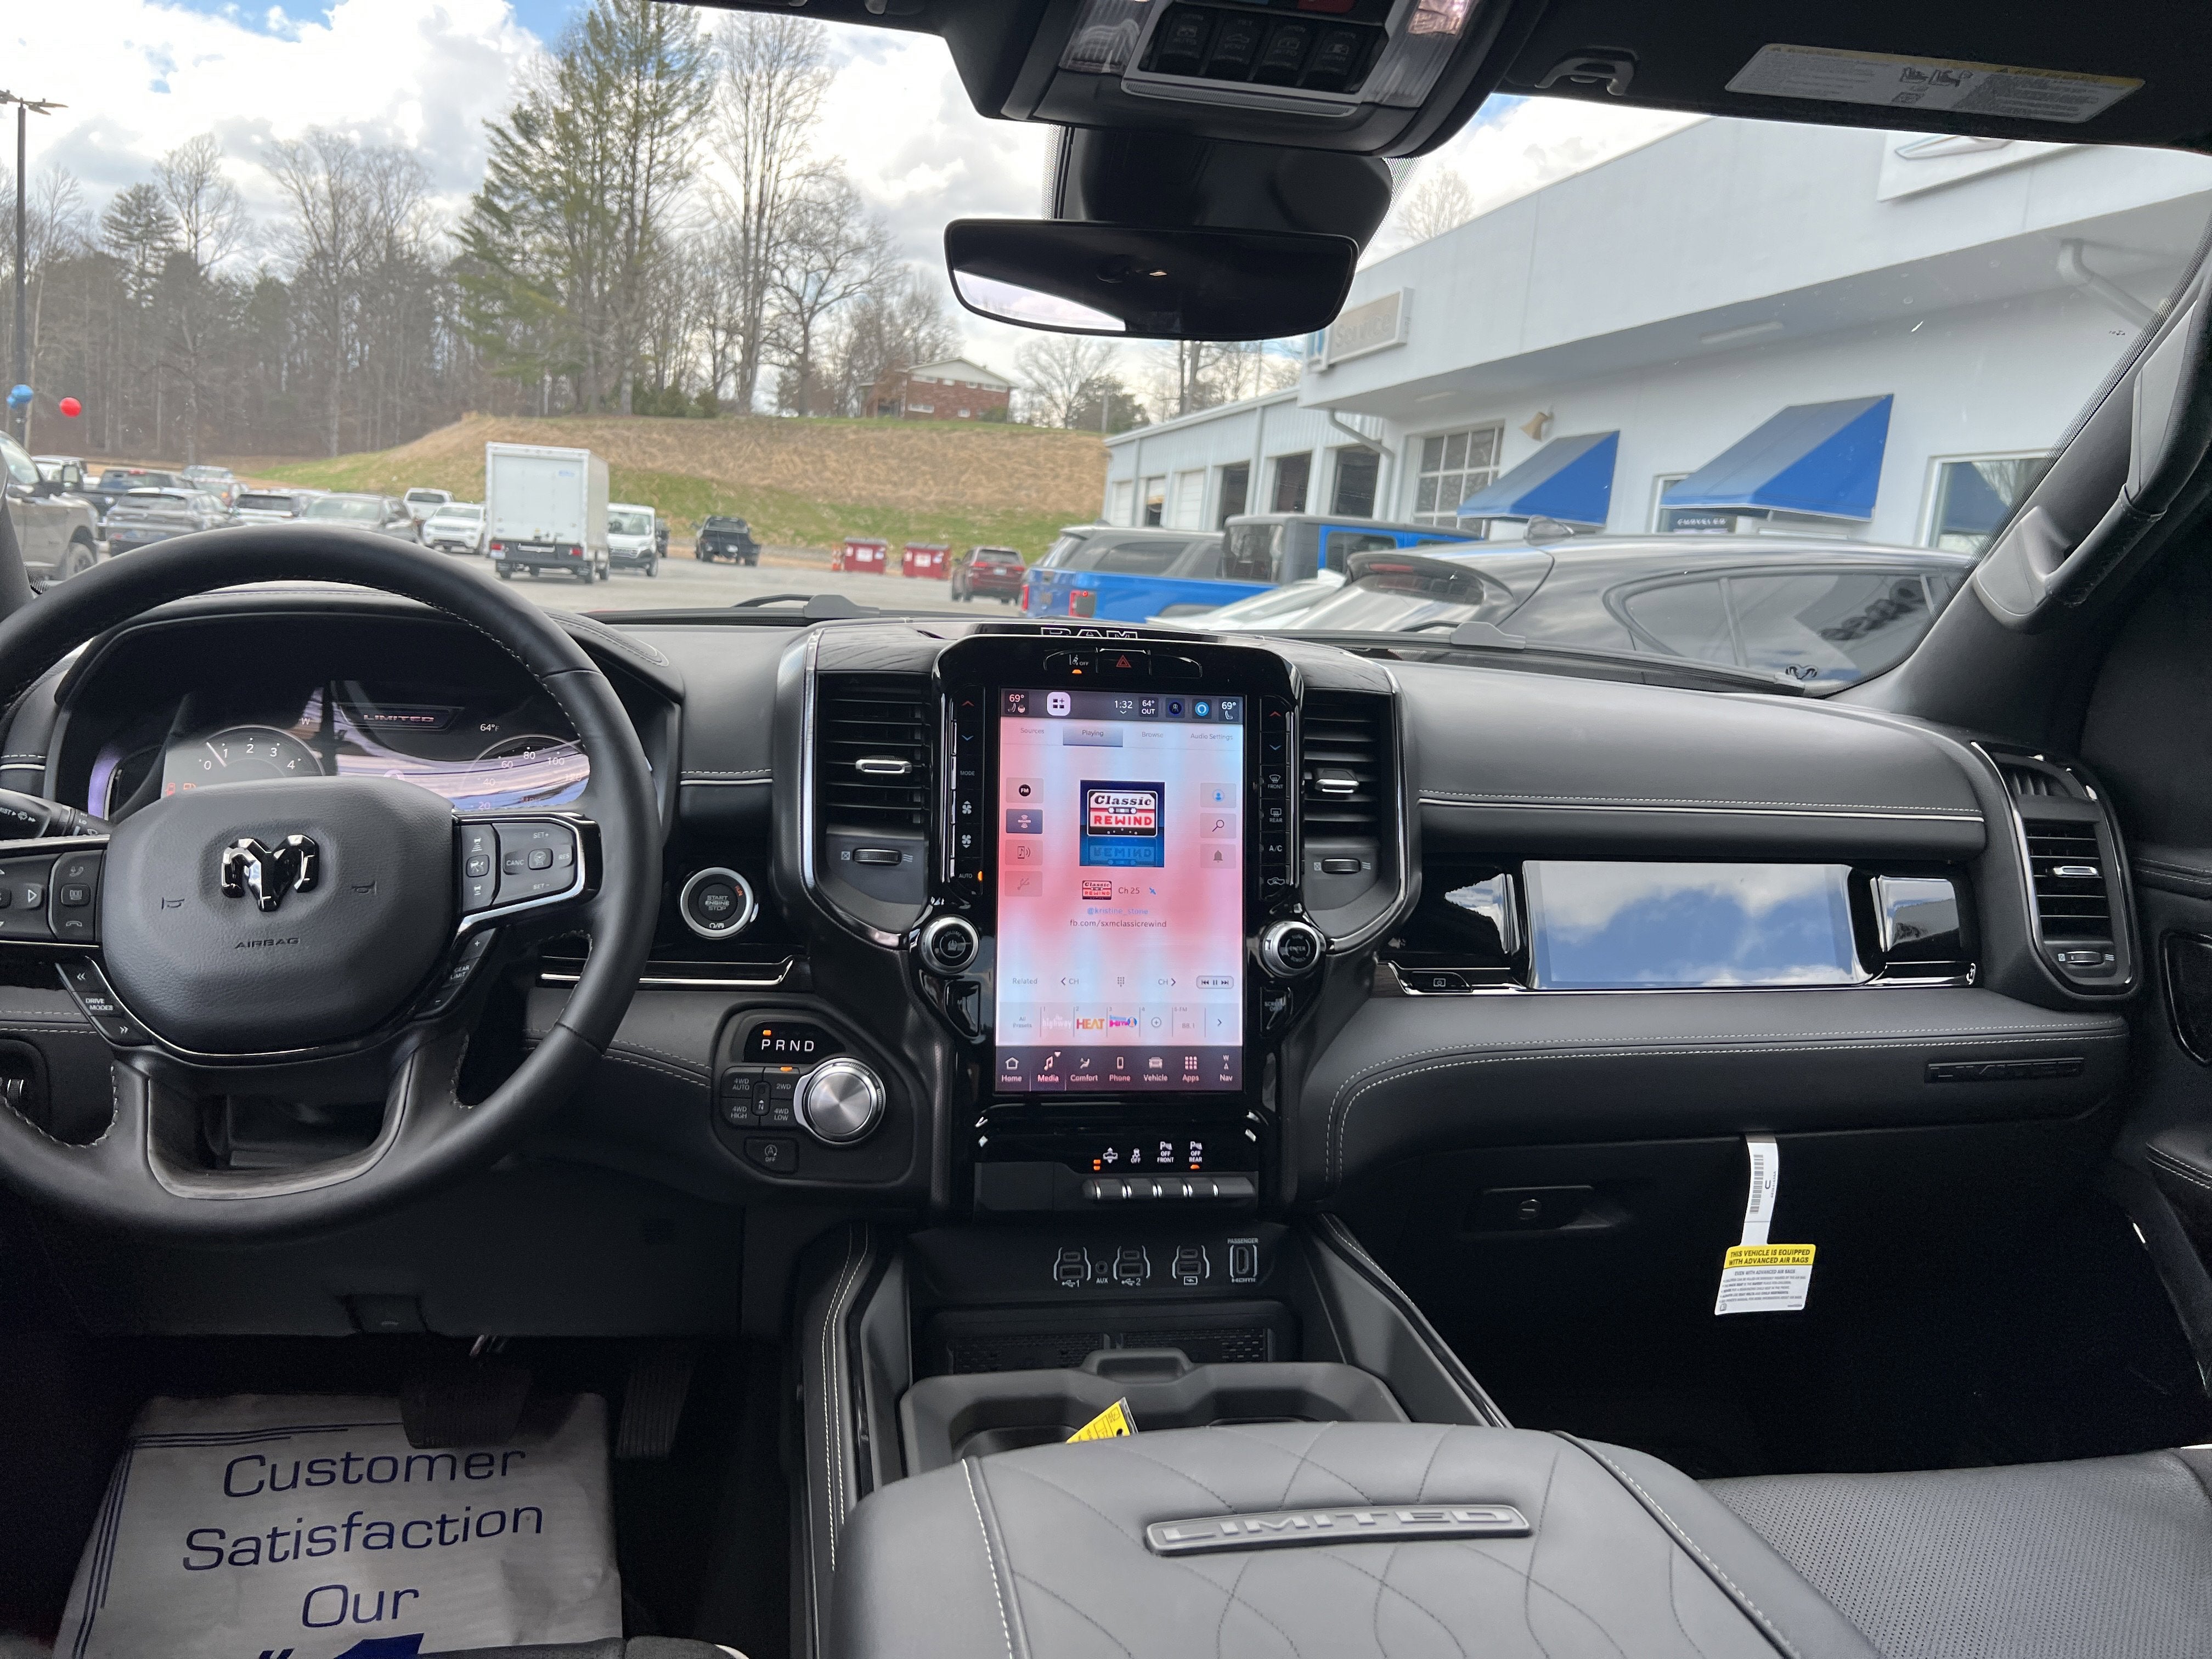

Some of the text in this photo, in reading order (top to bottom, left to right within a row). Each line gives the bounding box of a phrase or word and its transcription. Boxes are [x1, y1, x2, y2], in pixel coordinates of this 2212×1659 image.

[1335, 314, 1392, 348] Service
[1040, 627, 1138, 639] RAM
[1009, 694, 1025, 703] 69°
[1114, 700, 1133, 709] 1:32
[1221, 701, 1237, 710] 69°
[301, 717, 311, 725] W
[223, 748, 229, 758] 1
[246, 743, 254, 754] 2
[269, 747, 278, 757] 3
[523, 751, 536, 760] 80
[204, 760, 212, 770] 0
[287, 760, 295, 770] 4
[501, 760, 514, 769] 60
[547, 758, 565, 766] 100
[483, 778, 496, 787] 40
[1094, 794, 1153, 806] Classic
[478, 802, 491, 810] 20
[1094, 815, 1153, 826] REWIND
[1087, 907, 1148, 916] @kristine_stone
[1069, 919, 1167, 928] fb.com/sxmclassicrewind
[234, 938, 300, 950] AIRBAG
[1076, 1018, 1105, 1030] HEAT
[761, 1039, 815, 1052] P R N D
[1182, 1074, 1199, 1082] Apps
[1765, 1180, 1771, 1189] U
[223, 1448, 526, 1498] Customer
[1162, 1510, 1513, 1542] LIMITED
[182, 1504, 545, 1571] Satisfaction
[301, 1584, 420, 1629] Our
